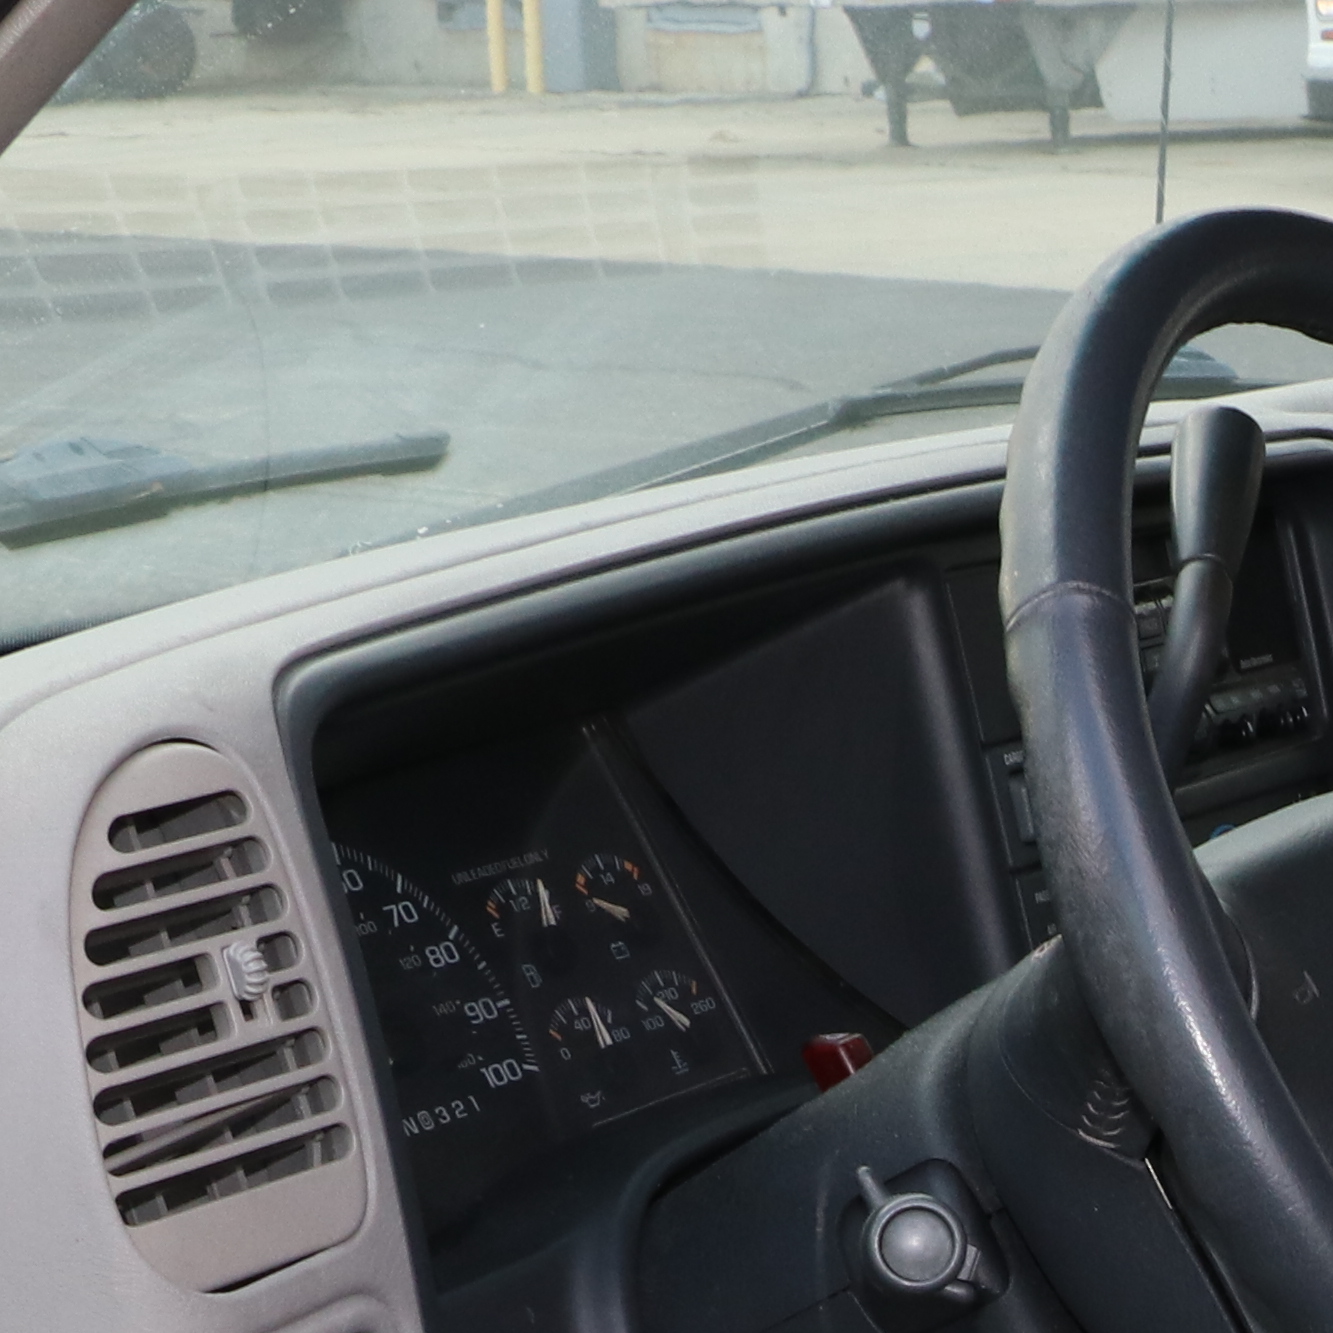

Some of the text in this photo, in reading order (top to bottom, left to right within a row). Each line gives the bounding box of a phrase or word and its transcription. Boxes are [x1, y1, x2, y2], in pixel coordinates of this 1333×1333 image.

[599, 872, 616, 886] 14
[381, 900, 420, 928] 70
[489, 920, 506, 938] E
[424, 940, 461, 969] 80
[463, 996, 499, 1024] 90
[689, 996, 717, 1015] 260
[573, 1015, 594, 1031] 40
[640, 1014, 665, 1031] 100
[610, 1026, 632, 1043] 80
[479, 1058, 523, 1089] 100
